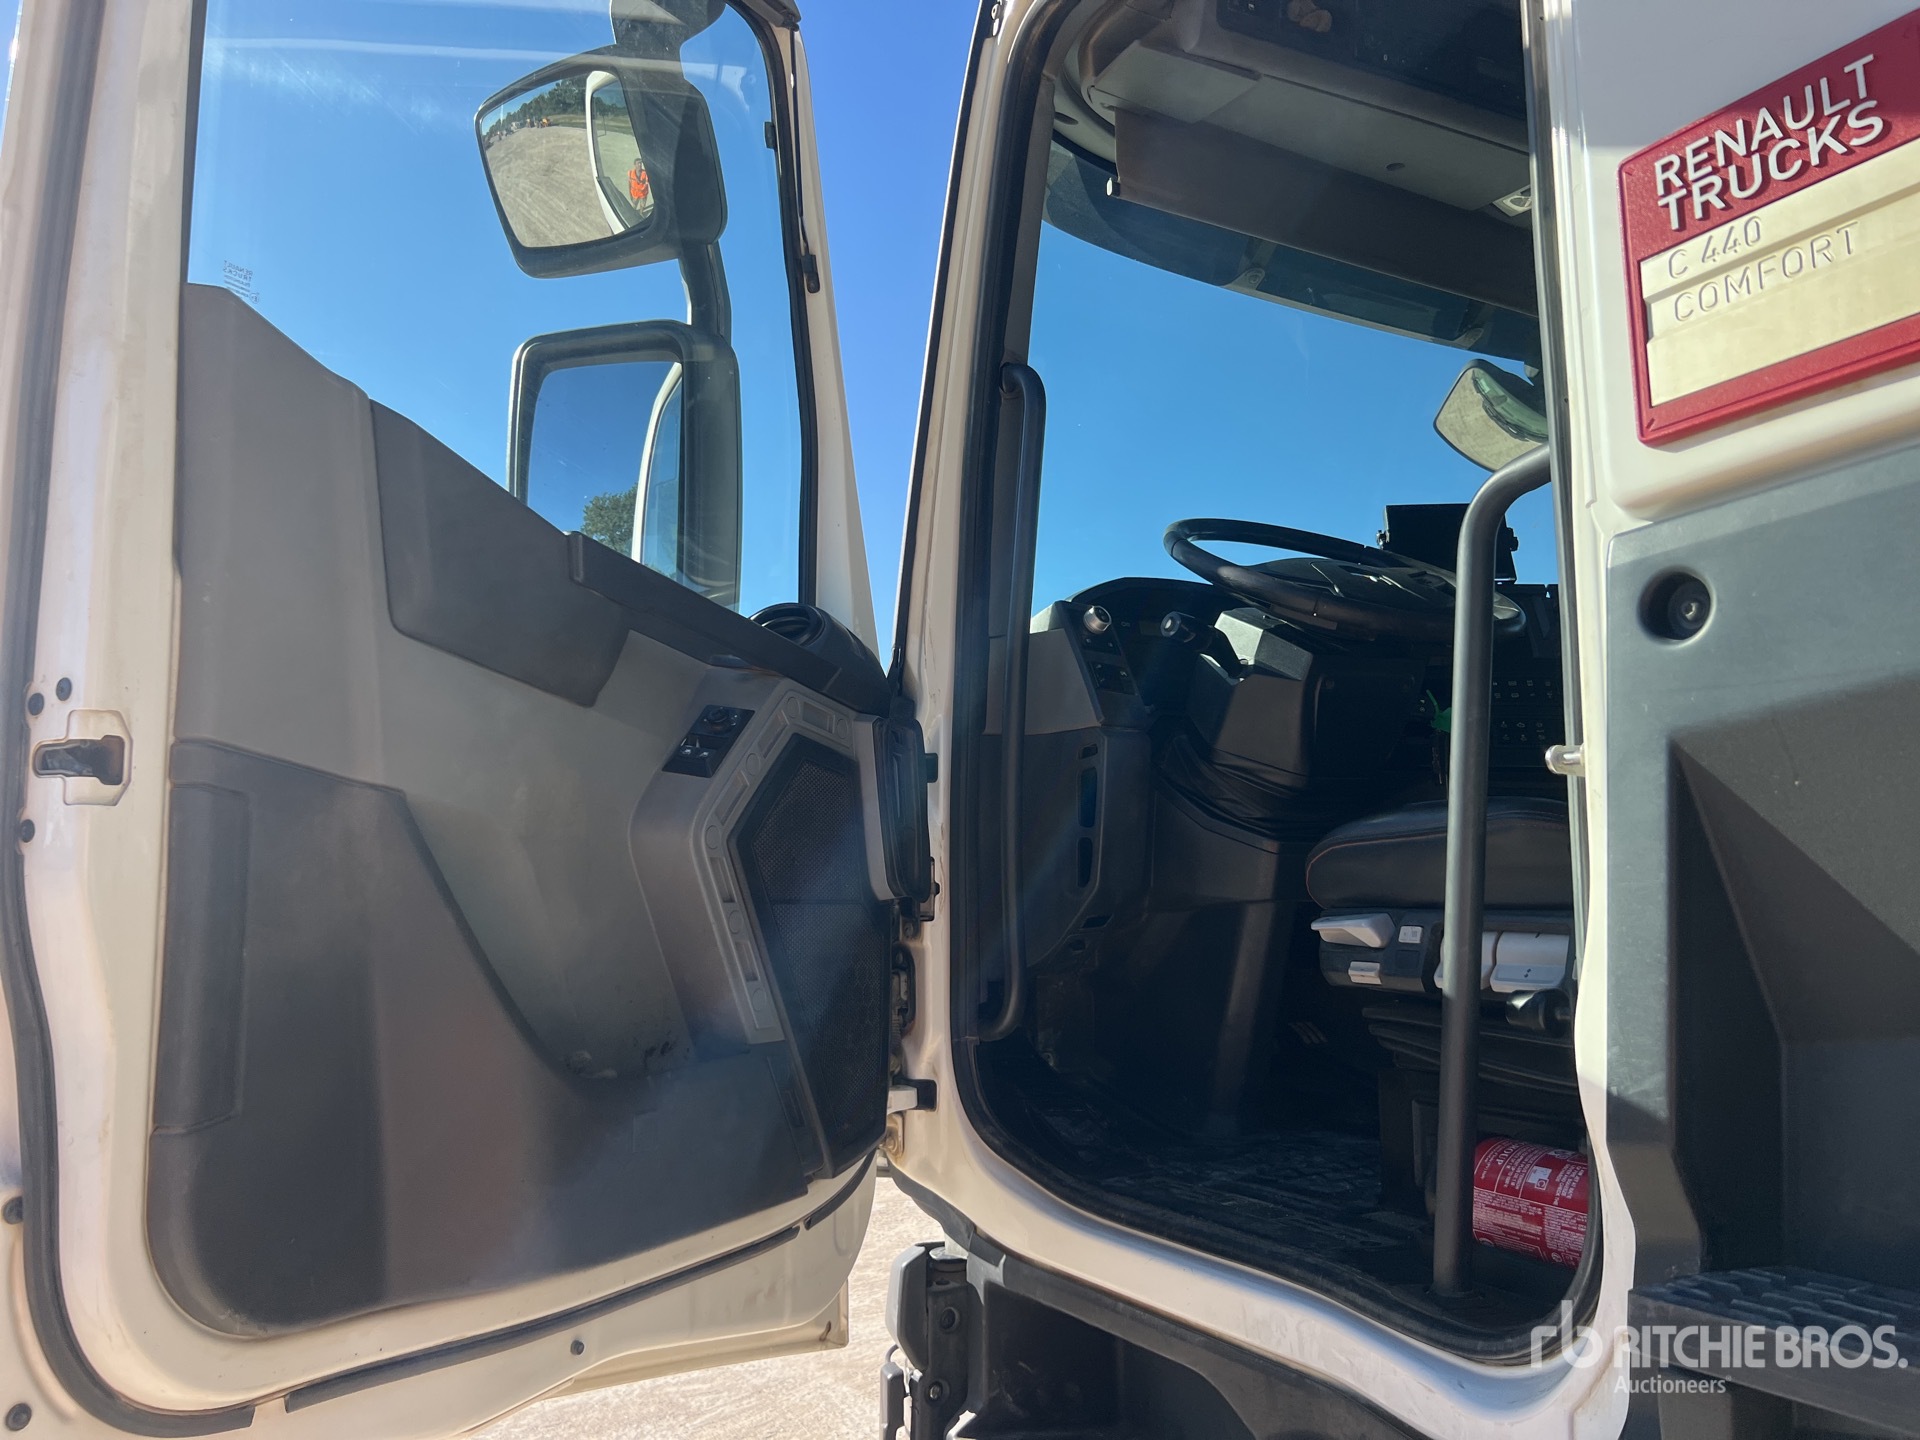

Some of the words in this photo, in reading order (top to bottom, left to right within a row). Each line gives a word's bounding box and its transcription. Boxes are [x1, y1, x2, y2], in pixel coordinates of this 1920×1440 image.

[1653, 54, 1875, 196] RENAULT
[1657, 100, 1885, 231] TRUCKS
[1668, 248, 1688, 280] C
[1701, 215, 1762, 263] 440
[1674, 221, 1859, 322] COMFORT
